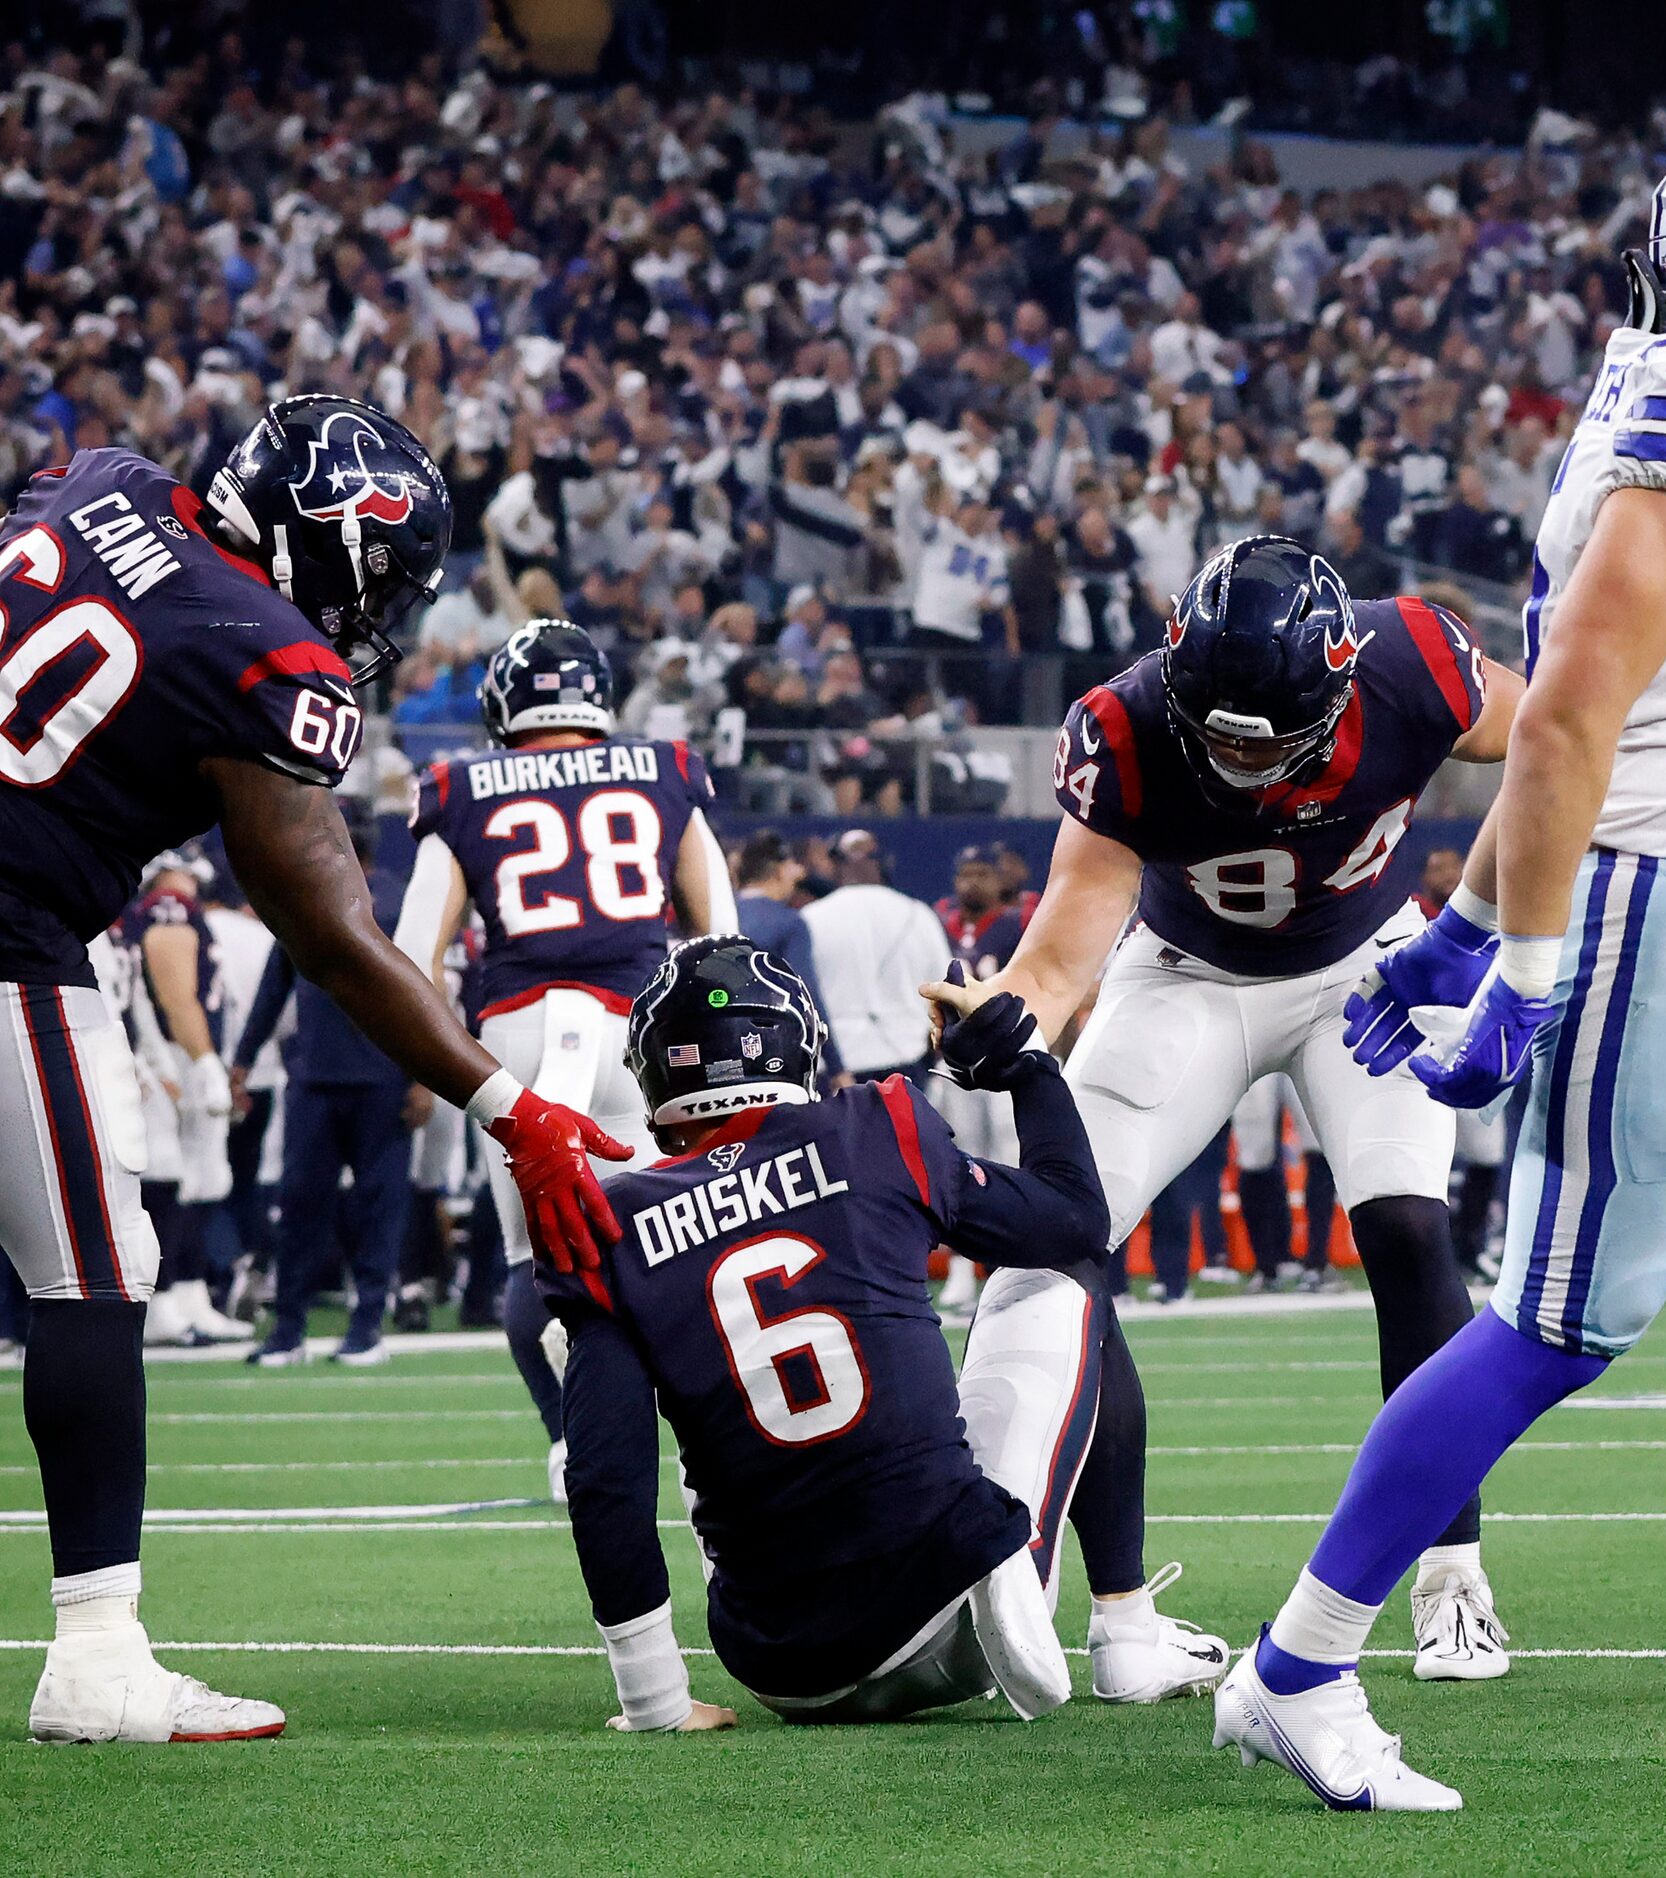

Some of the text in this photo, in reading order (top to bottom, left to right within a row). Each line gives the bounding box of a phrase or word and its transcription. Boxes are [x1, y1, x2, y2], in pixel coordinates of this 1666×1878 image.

[69, 491, 182, 601] CANN
[289, 687, 363, 771] 60
[467, 747, 659, 801] BURKHEAD
[1053, 727, 1101, 820] 84
[483, 788, 666, 939] 28
[1187, 797, 1415, 931] 84
[681, 1093, 778, 1115] TEXANS
[633, 1141, 848, 1268] DRISKEL
[706, 1229, 872, 1448] 6
